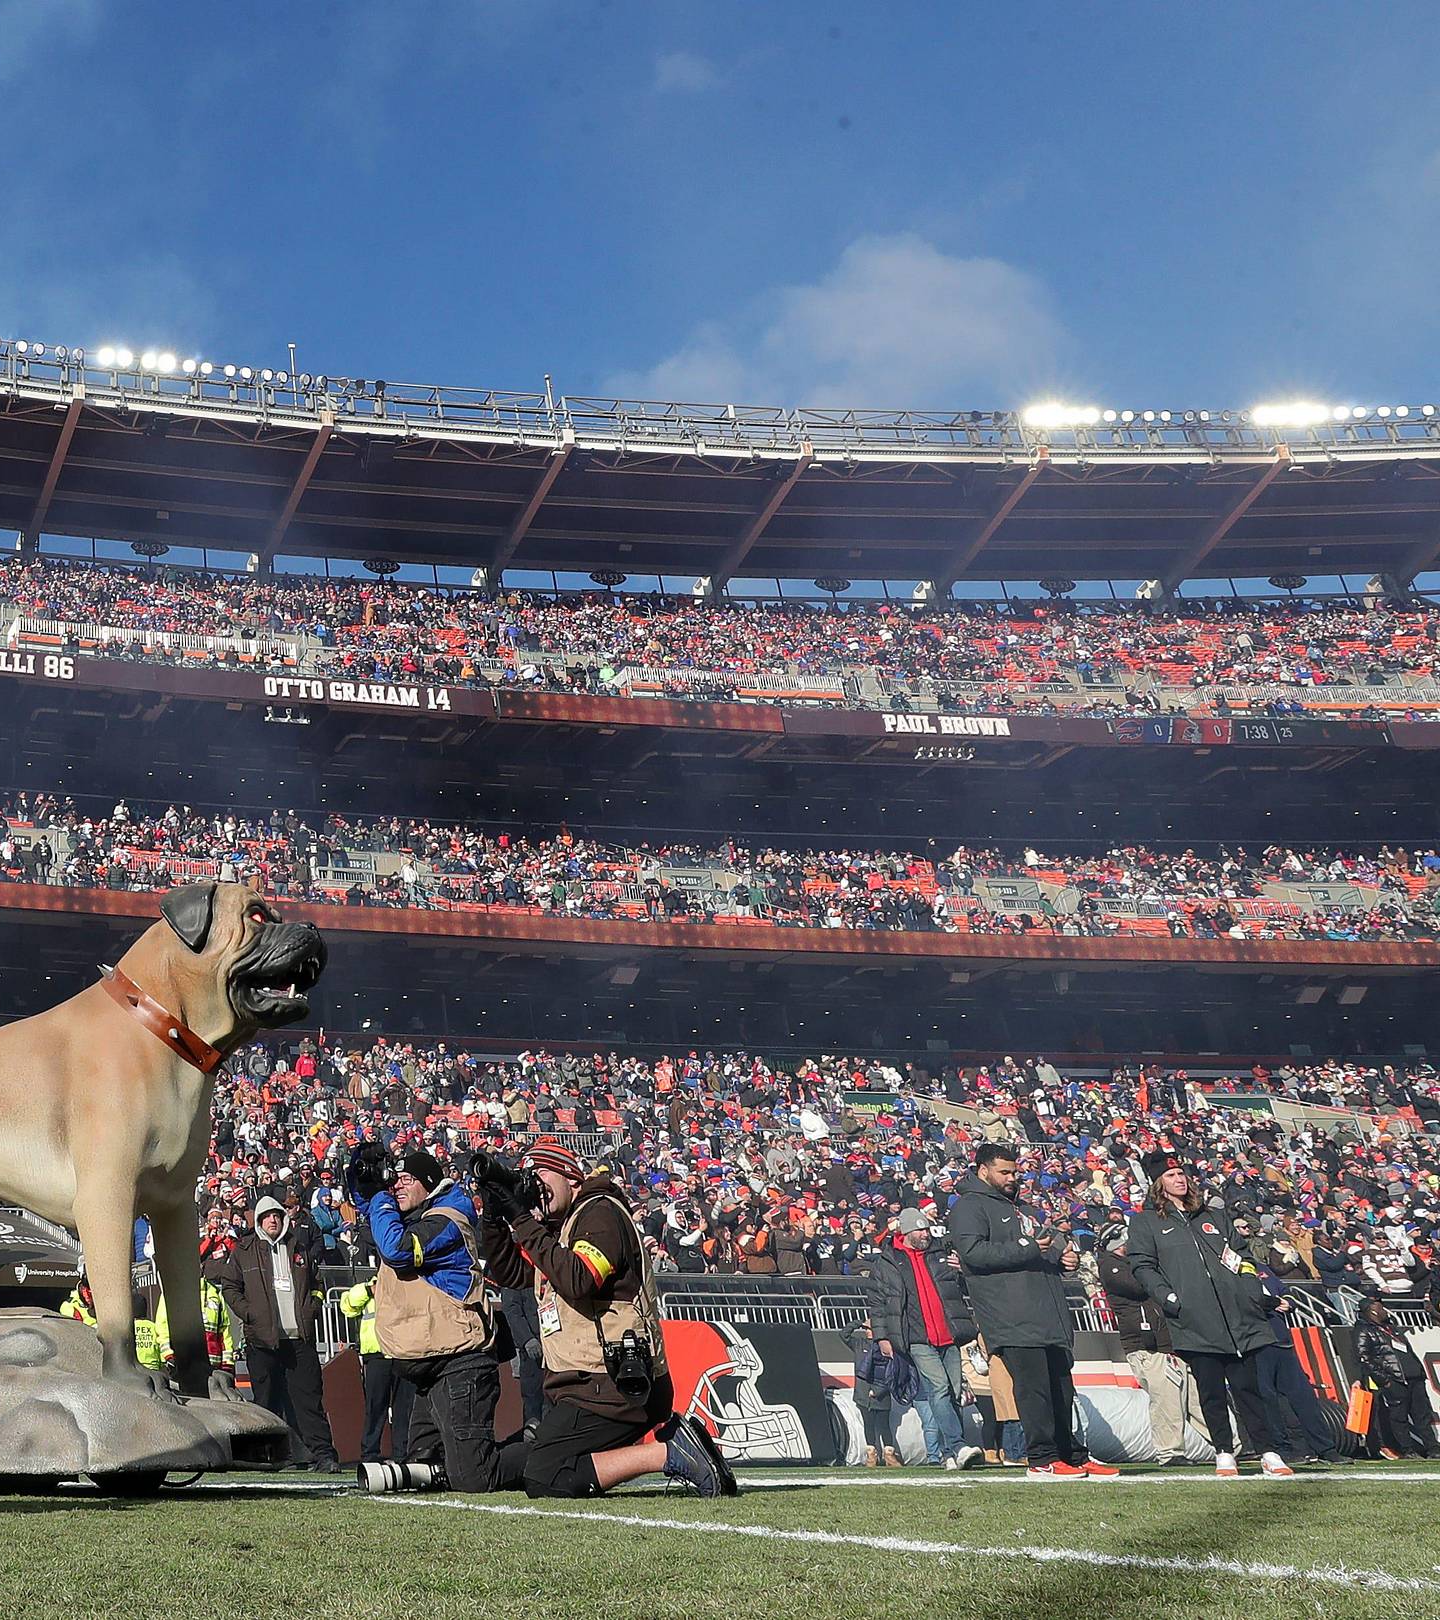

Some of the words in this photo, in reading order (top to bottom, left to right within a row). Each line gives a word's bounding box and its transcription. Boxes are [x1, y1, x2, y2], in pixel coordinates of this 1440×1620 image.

[43, 655, 74, 680] 86
[264, 676, 324, 699] OTTO
[329, 681, 419, 707] GRAHAM
[426, 687, 451, 711] 14
[881, 713, 937, 734] PAUL
[938, 715, 1011, 736] BROWN
[1241, 725, 1269, 740] 7:38
[1280, 727, 1293, 739] 25
[27, 1269, 54, 1277] University
[136, 1326, 152, 1334] PEX
[135, 1341, 153, 1349] ROUP
